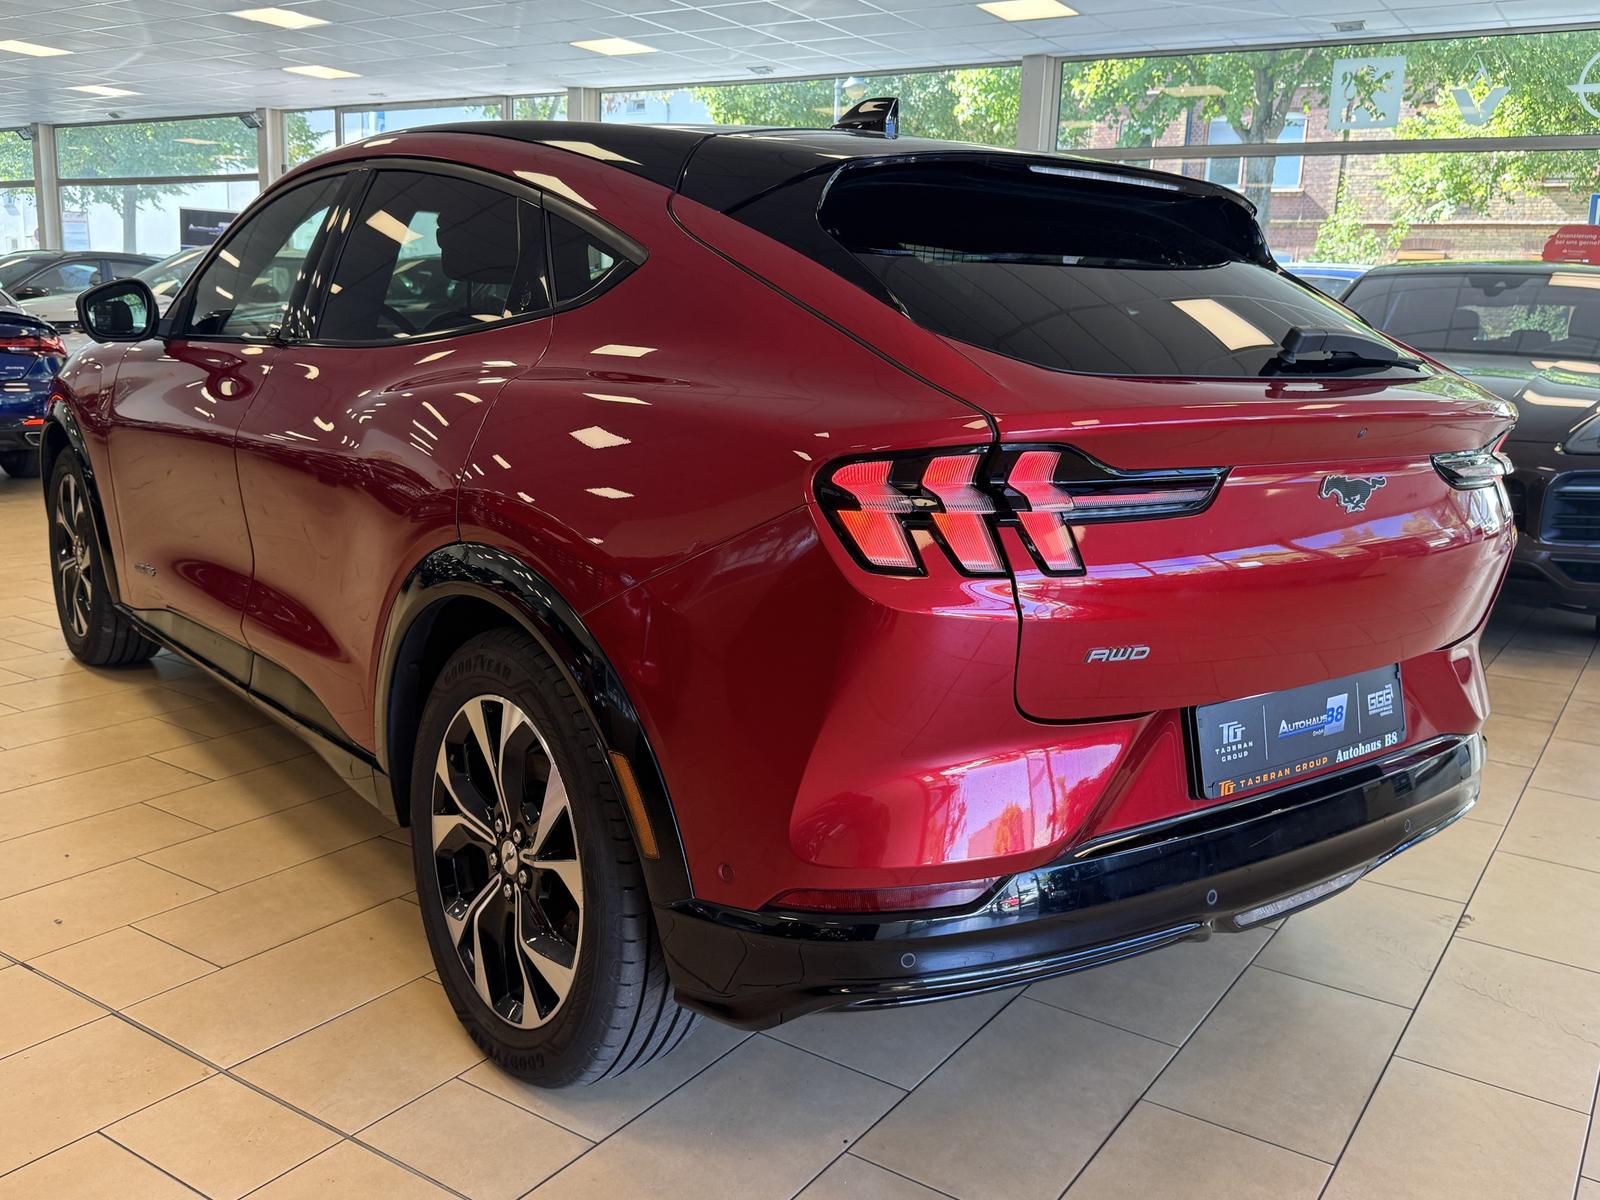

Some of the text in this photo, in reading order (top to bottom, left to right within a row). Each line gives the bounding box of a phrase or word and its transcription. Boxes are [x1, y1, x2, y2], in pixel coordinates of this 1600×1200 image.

[1086, 646, 1150, 663] AWD
[1221, 750, 1249, 762] GROUP
[1239, 768, 1291, 788] TAJERAN
[1295, 756, 1329, 773] GROUP
[1335, 738, 1382, 763] Autohaus
[1384, 731, 1398, 747] B8
